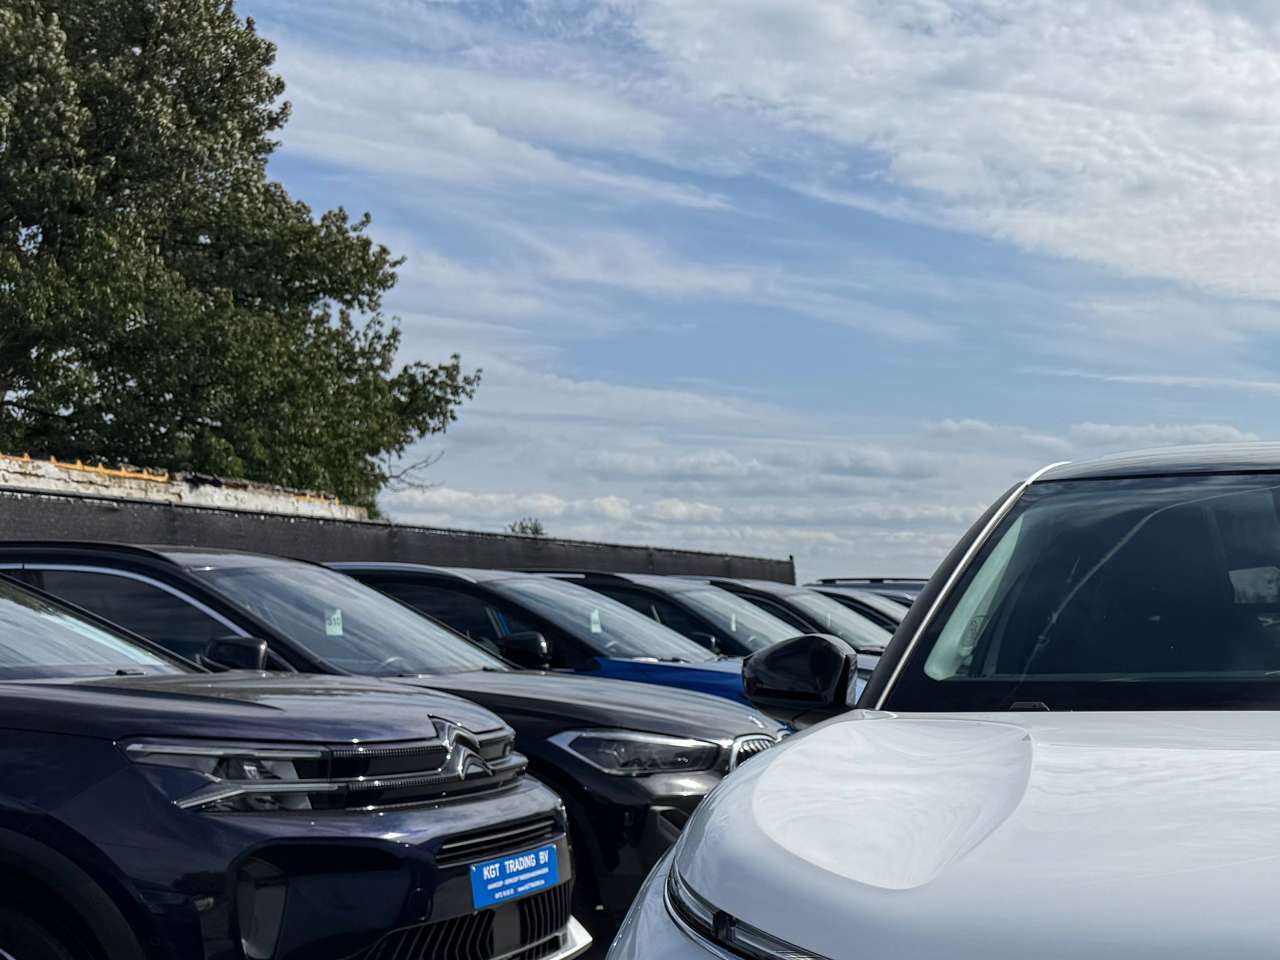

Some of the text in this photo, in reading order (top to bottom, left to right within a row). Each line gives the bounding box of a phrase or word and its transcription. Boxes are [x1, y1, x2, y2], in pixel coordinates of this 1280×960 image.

[483, 863, 500, 880] KGT
[504, 854, 537, 874] TRADING
[538, 850, 549, 864] BV
